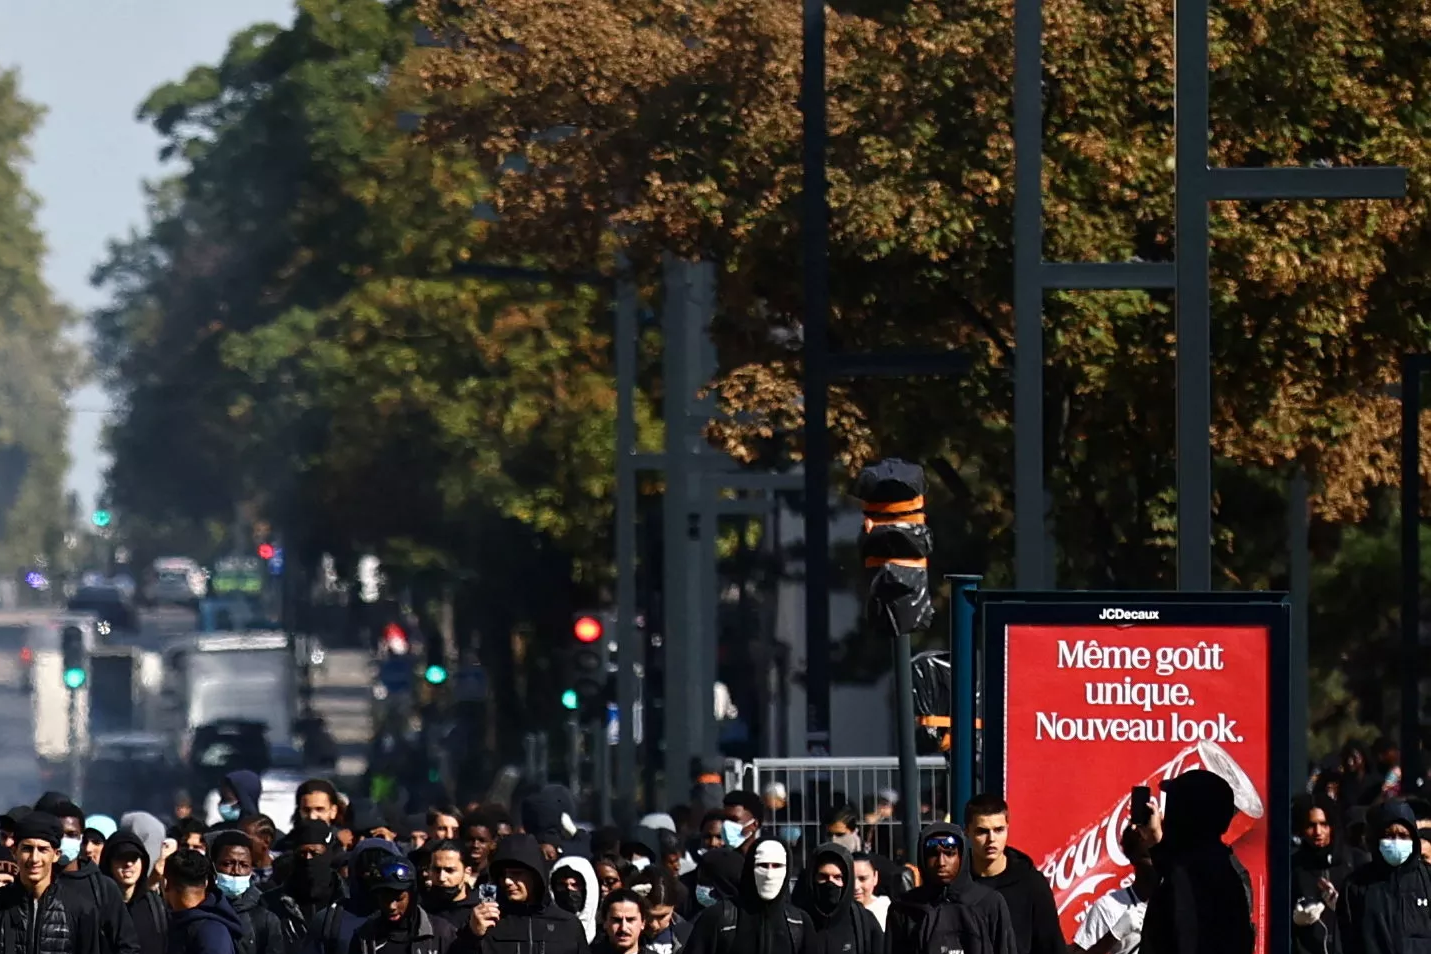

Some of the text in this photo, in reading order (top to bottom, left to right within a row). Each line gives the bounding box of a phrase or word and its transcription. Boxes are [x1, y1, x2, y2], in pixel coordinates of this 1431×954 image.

[1099, 608, 1159, 620] JCDecaux
[1057, 640, 1225, 676] Même goût
[1084, 676, 1195, 712] unique.
[1035, 711, 1244, 743] Nouveau look.
